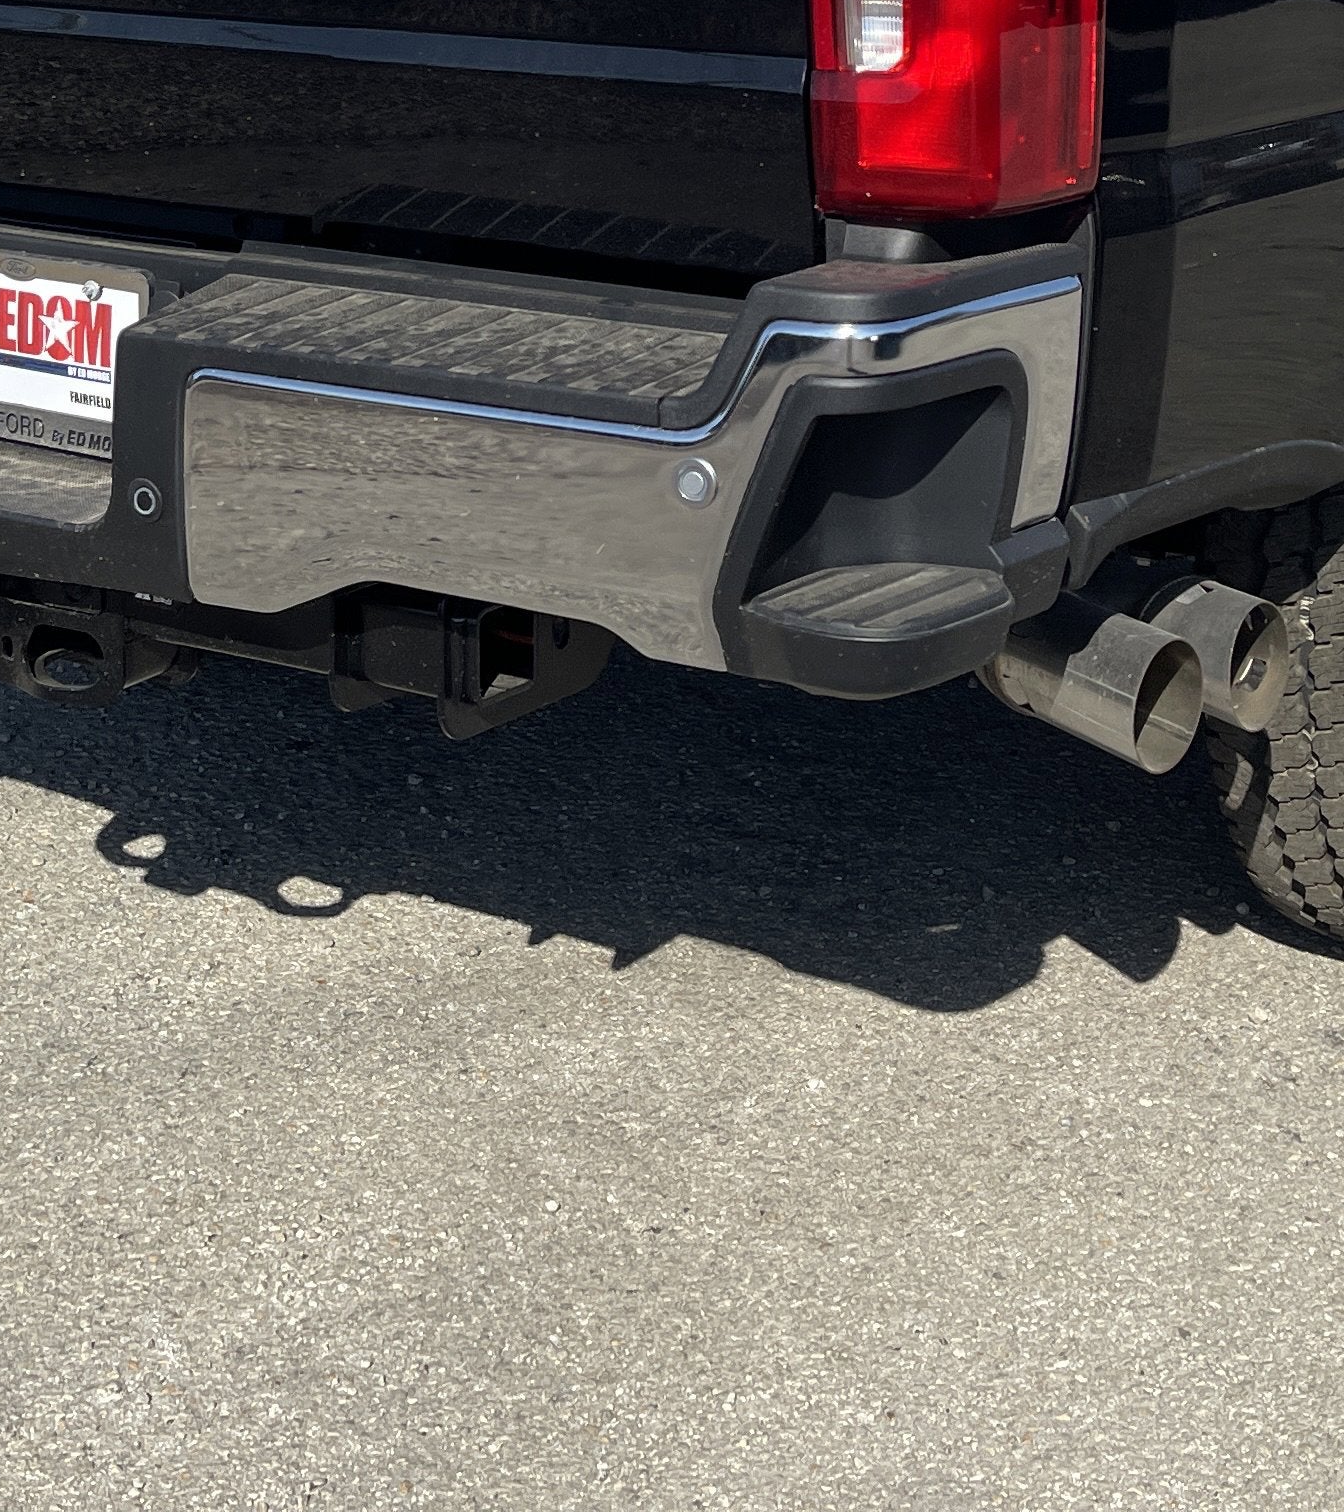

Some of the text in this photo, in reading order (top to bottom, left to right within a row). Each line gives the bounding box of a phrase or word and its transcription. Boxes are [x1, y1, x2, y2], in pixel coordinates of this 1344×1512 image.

[69, 390, 112, 409] FAIRFIELD
[67, 429, 86, 447] ED
[87, 433, 112, 453] MO
